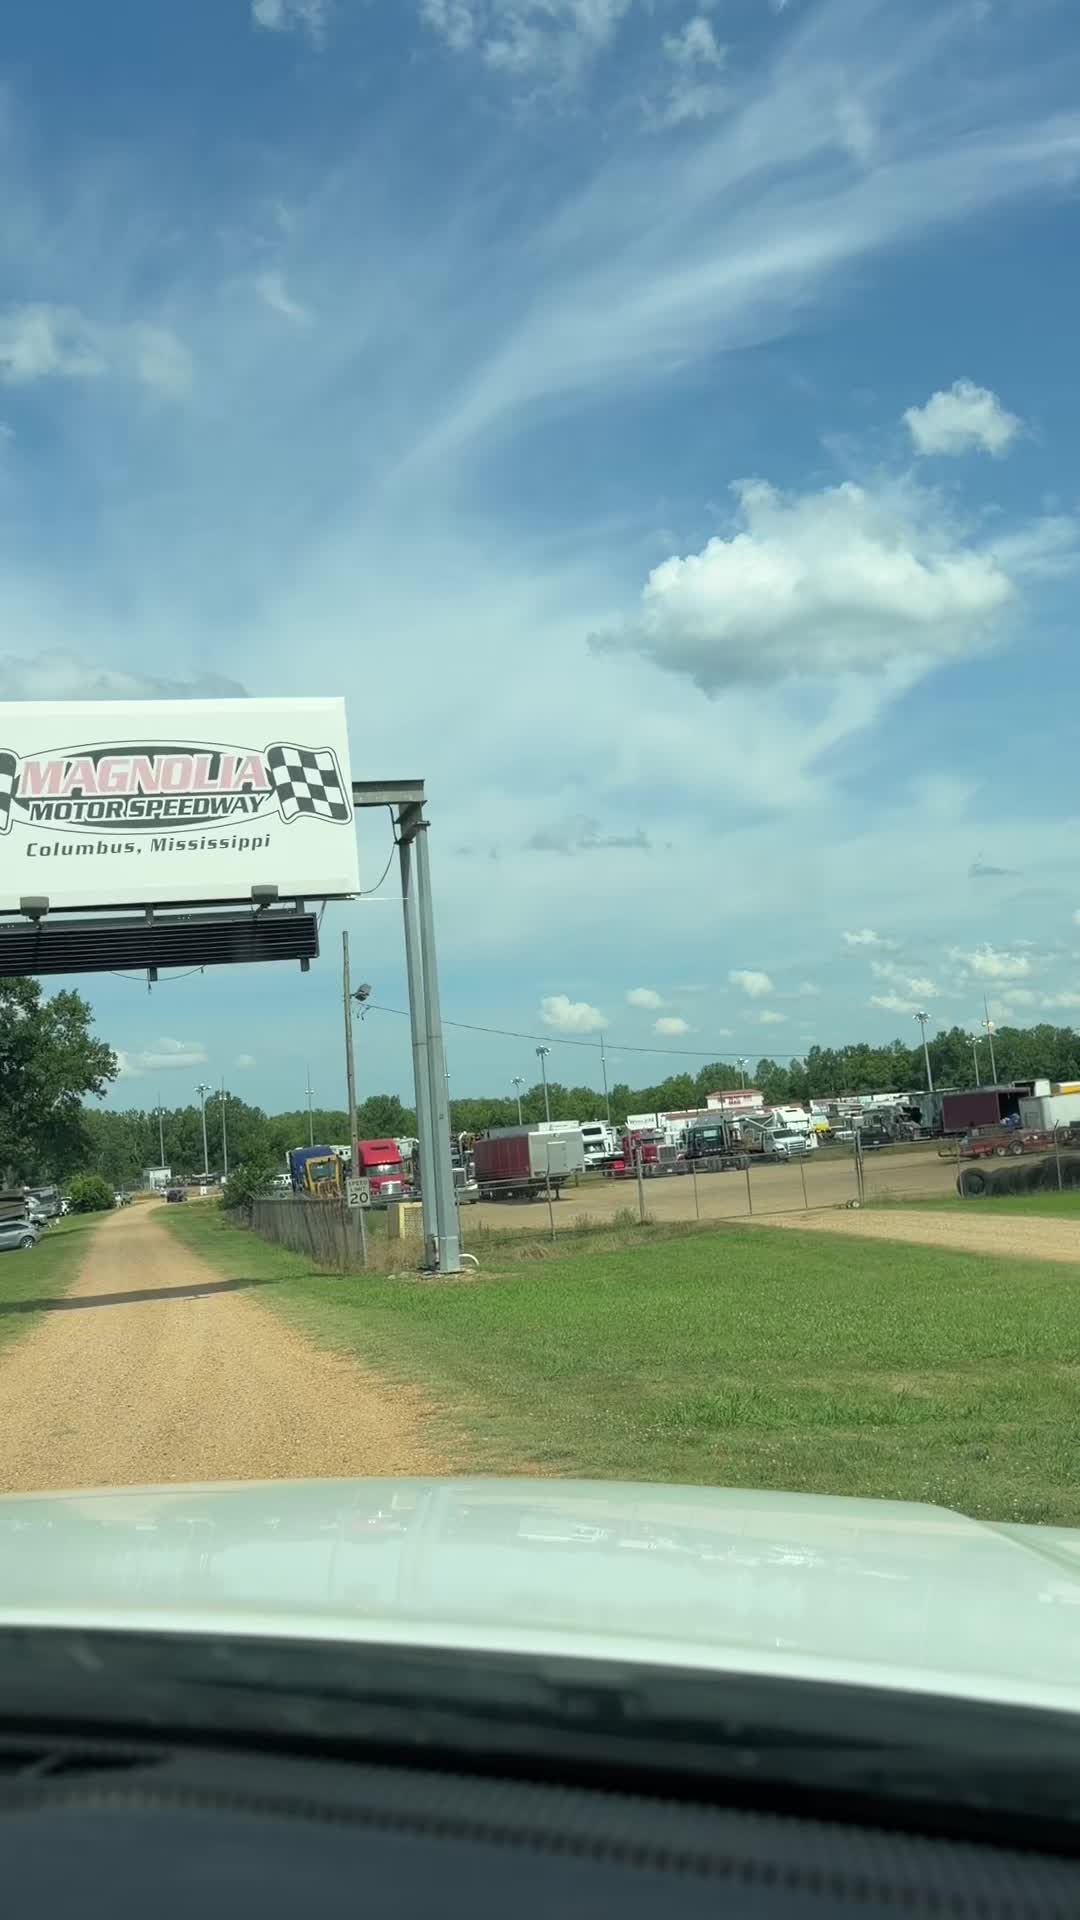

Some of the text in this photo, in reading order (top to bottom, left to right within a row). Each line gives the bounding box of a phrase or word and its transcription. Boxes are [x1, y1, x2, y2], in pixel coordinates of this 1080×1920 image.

[20, 754, 271, 795] MAGNOLIA
[30, 796, 264, 821] MOTOR SPEEDWAY
[26, 834, 271, 858] Columbus, Mississippi
[350, 1192, 368, 1204] 20
